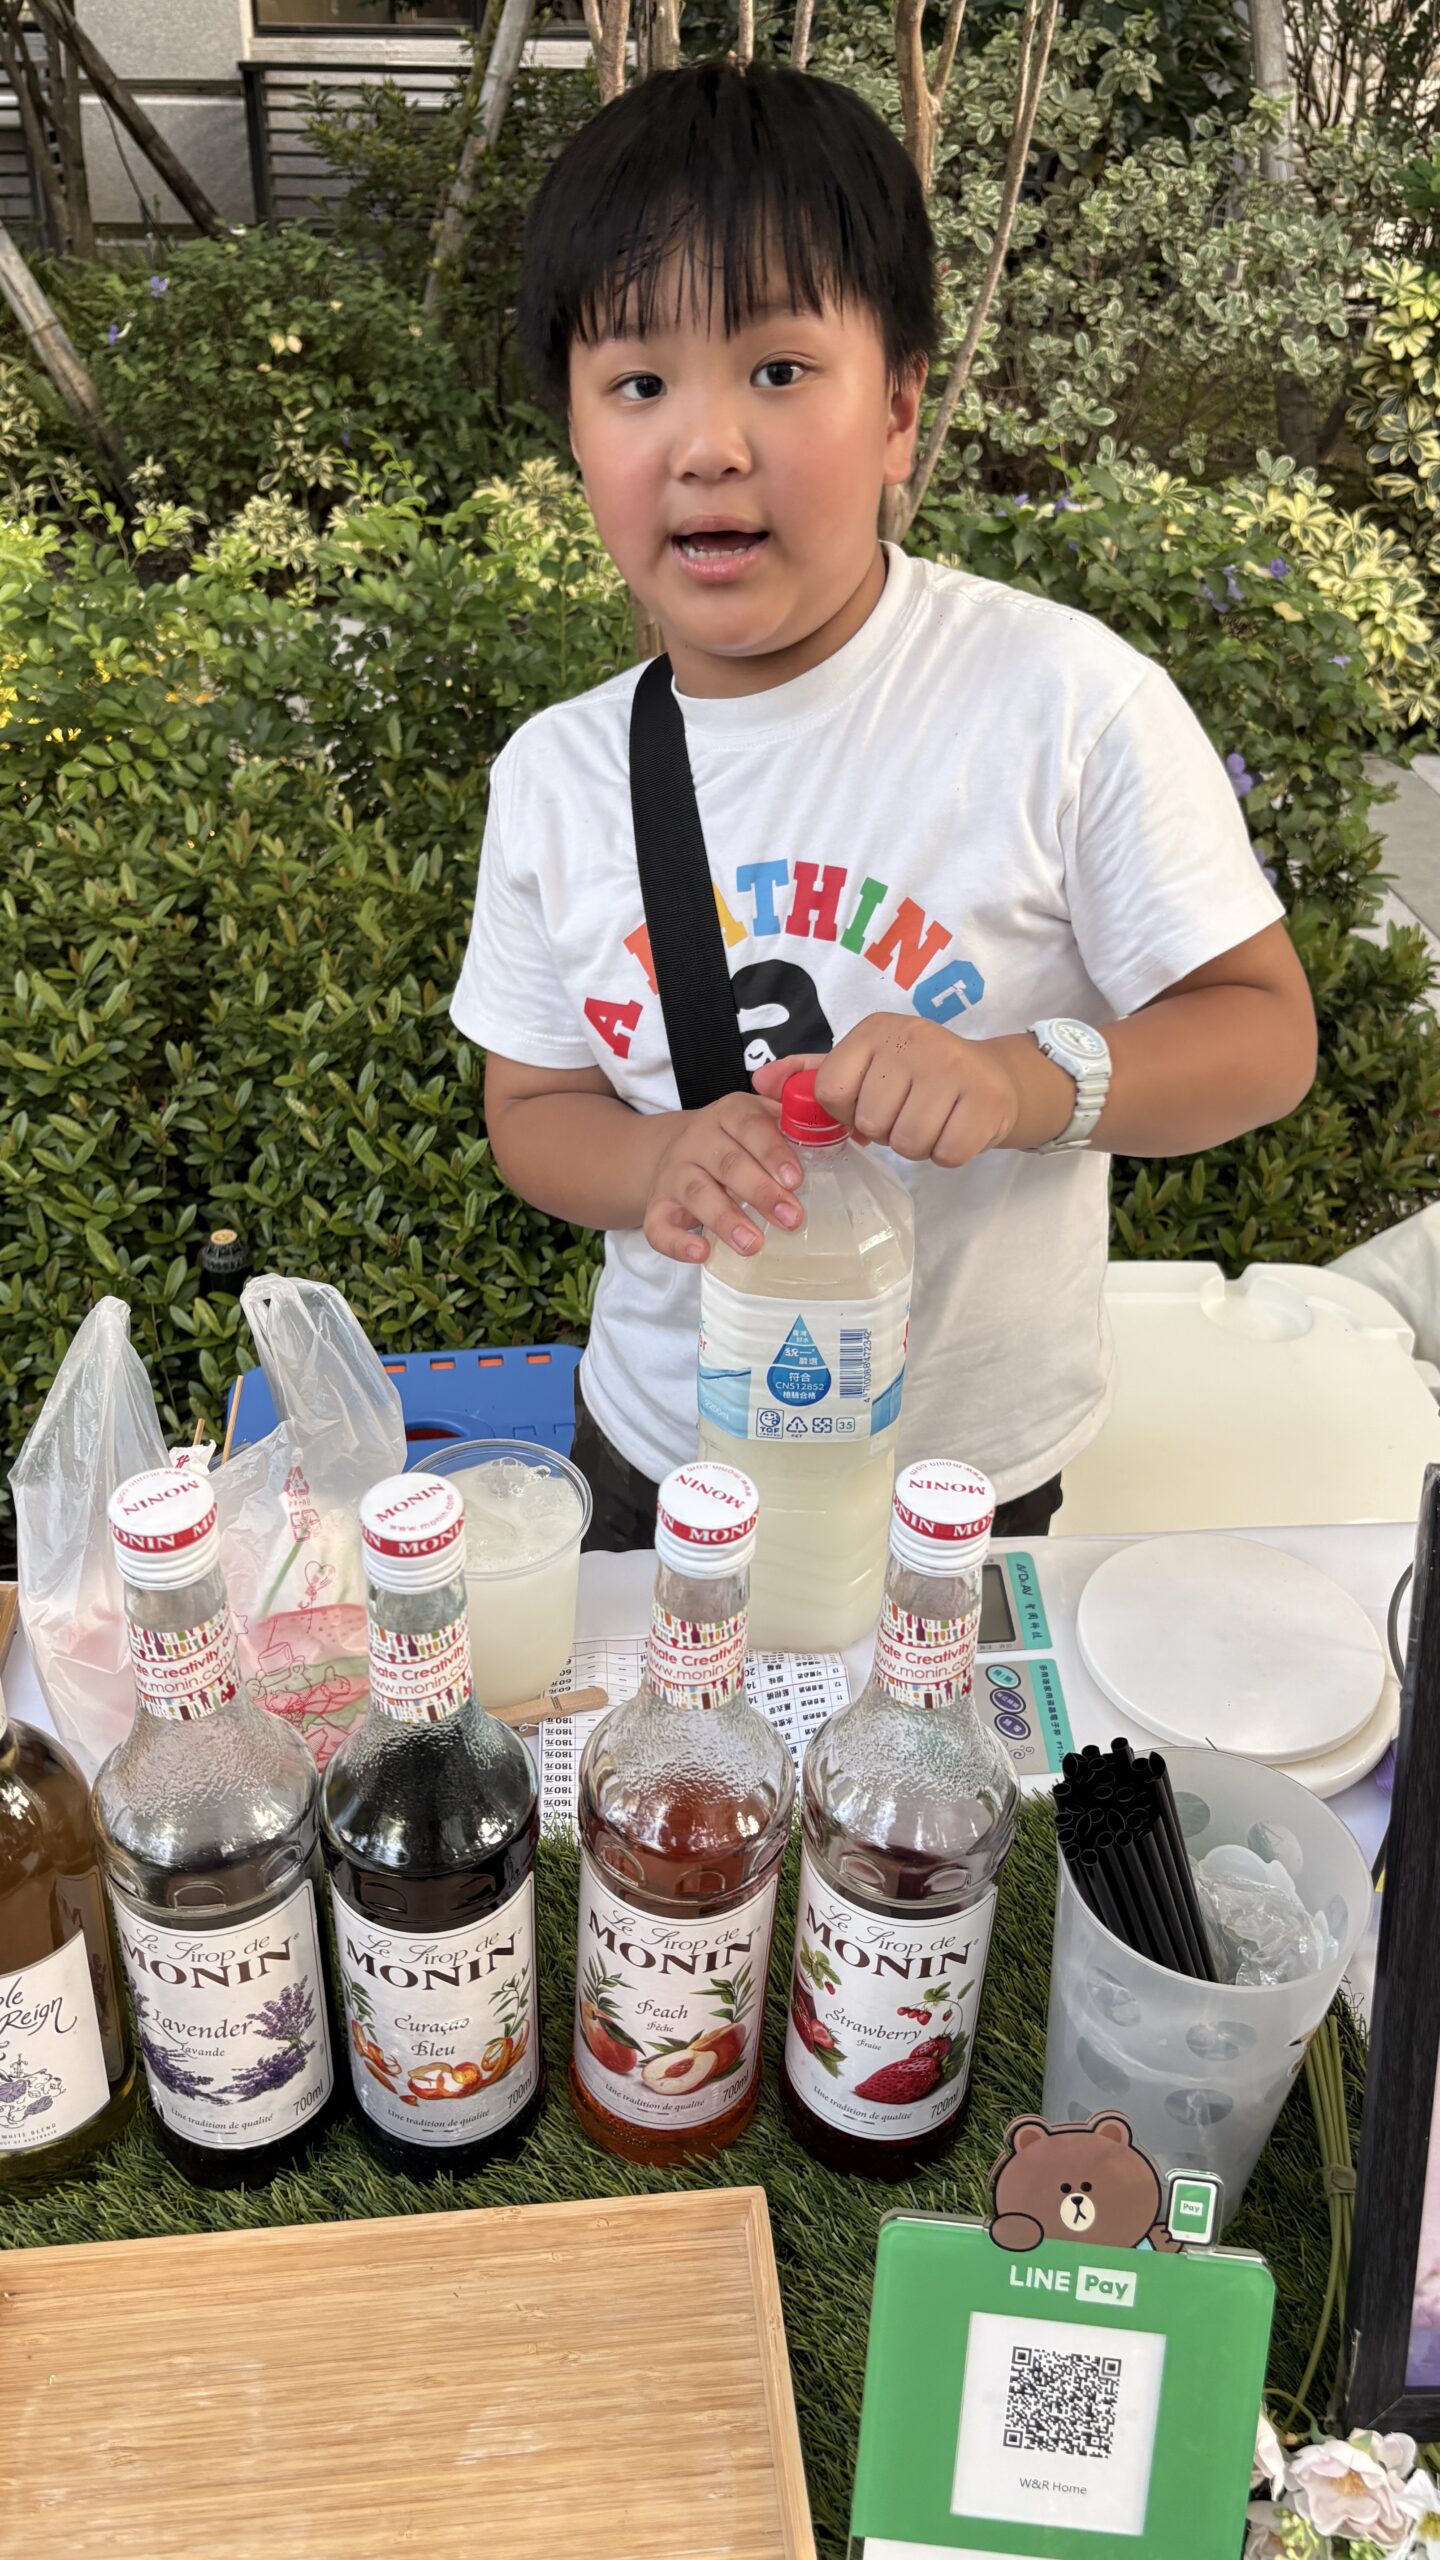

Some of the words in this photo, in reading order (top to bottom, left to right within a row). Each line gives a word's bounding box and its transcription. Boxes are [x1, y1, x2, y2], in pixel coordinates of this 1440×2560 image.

[584, 997, 643, 1059] A
[784, 1347, 812, 1356] 統一
[775, 1382, 825, 1391] CNS12852
[789, 1372, 811, 1382] 符合
[783, 1391, 816, 1399] 檢驗合格
[838, 1421, 853, 1430] 35
[122, 1480, 200, 1516] MONIN
[675, 1474, 745, 1509] MONIN
[909, 1479, 986, 1495] MONIN
[375, 1482, 446, 1522] MONIN
[152, 1646, 219, 1679] Creativity
[767, 1689, 789, 1700] 藍柑橘
[769, 1702, 791, 1714] 薰衣草
[545, 1739, 573, 1747] 180元
[780, 1731, 791, 1740] 草
[544, 1787, 573, 1795] 180元
[544, 1799, 573, 1807] 160元
[588, 1907, 756, 1976] MONIN
[602, 1909, 636, 1935] Le
[640, 1927, 708, 1954] Sirop
[715, 1927, 740, 1946] de
[805, 1903, 972, 1980] MONIN
[819, 1904, 852, 1934] Le
[855, 1925, 923, 1958] Sirop
[930, 1935, 956, 1952] de
[130, 1928, 159, 1954] Le
[167, 1941, 236, 1968] Sirop
[244, 1935, 270, 1955] de
[358, 1934, 392, 1958] Le
[399, 1944, 468, 1967] Sirop
[475, 1932, 500, 1952] de
[122, 1931, 293, 1989] MONIN
[346, 1931, 517, 1990] MONIN
[0, 1996, 78, 2036] Reign
[635, 1999, 689, 2020] Peach
[153, 2008, 253, 2044] Lavender
[646, 2021, 674, 2033] Pêche
[825, 2007, 922, 2045] Strawberry
[179, 2042, 225, 2059] Lavande
[411, 2040, 456, 2057] Bleu
[856, 2038, 882, 2051] Fraise
[507, 2071, 533, 2109] 700ml
[722, 2070, 749, 2102] 700ml
[292, 2078, 324, 2117] 700ml
[622, 2093, 660, 2110] tradition
[661, 2101, 673, 2111] de
[674, 2099, 706, 2112] qualité
[930, 2086, 960, 2119] 700ml
[188, 2116, 227, 2130] tradition
[228, 2119, 240, 2130] de
[241, 2113, 274, 2130] qualité
[405, 2116, 446, 2128] tradition
[447, 2118, 458, 2128] de
[459, 2109, 491, 2128] qualité
[829, 2099, 867, 2120] tradition
[868, 2111, 880, 2121] de
[881, 2111, 914, 2122] qualité
[1182, 2202, 1201, 2213] Pay
[1010, 2264, 1071, 2293] LINE
[1084, 2273, 1129, 2300] Pay
[1019, 2477, 1050, 2491] W&R
[1052, 2481, 1087, 2495] Home
